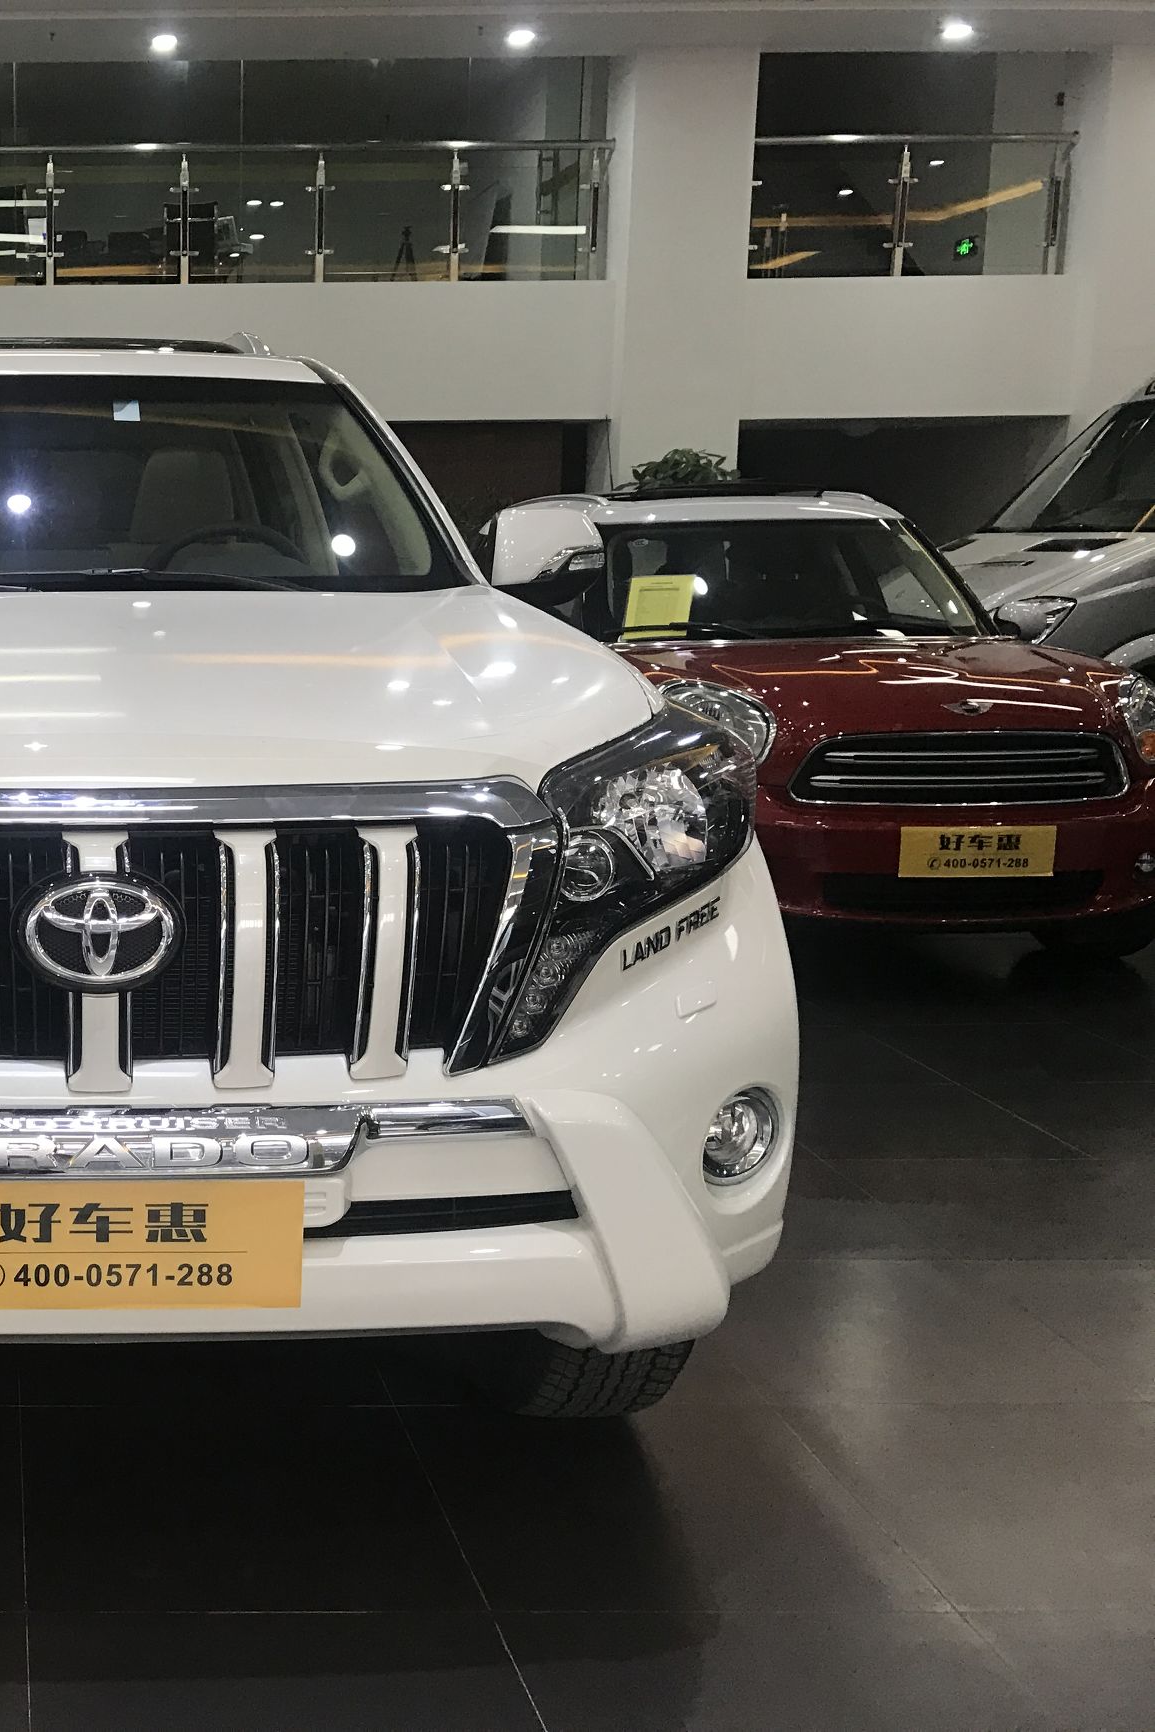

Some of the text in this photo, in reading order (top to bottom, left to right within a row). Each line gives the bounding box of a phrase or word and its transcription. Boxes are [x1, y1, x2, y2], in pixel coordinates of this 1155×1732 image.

[938, 833, 1023, 851] 好车惠
[943, 857, 1029, 868] 400-0571-288
[620, 926, 671, 971] LAND
[14, 1263, 233, 1287] 400-0571-288
